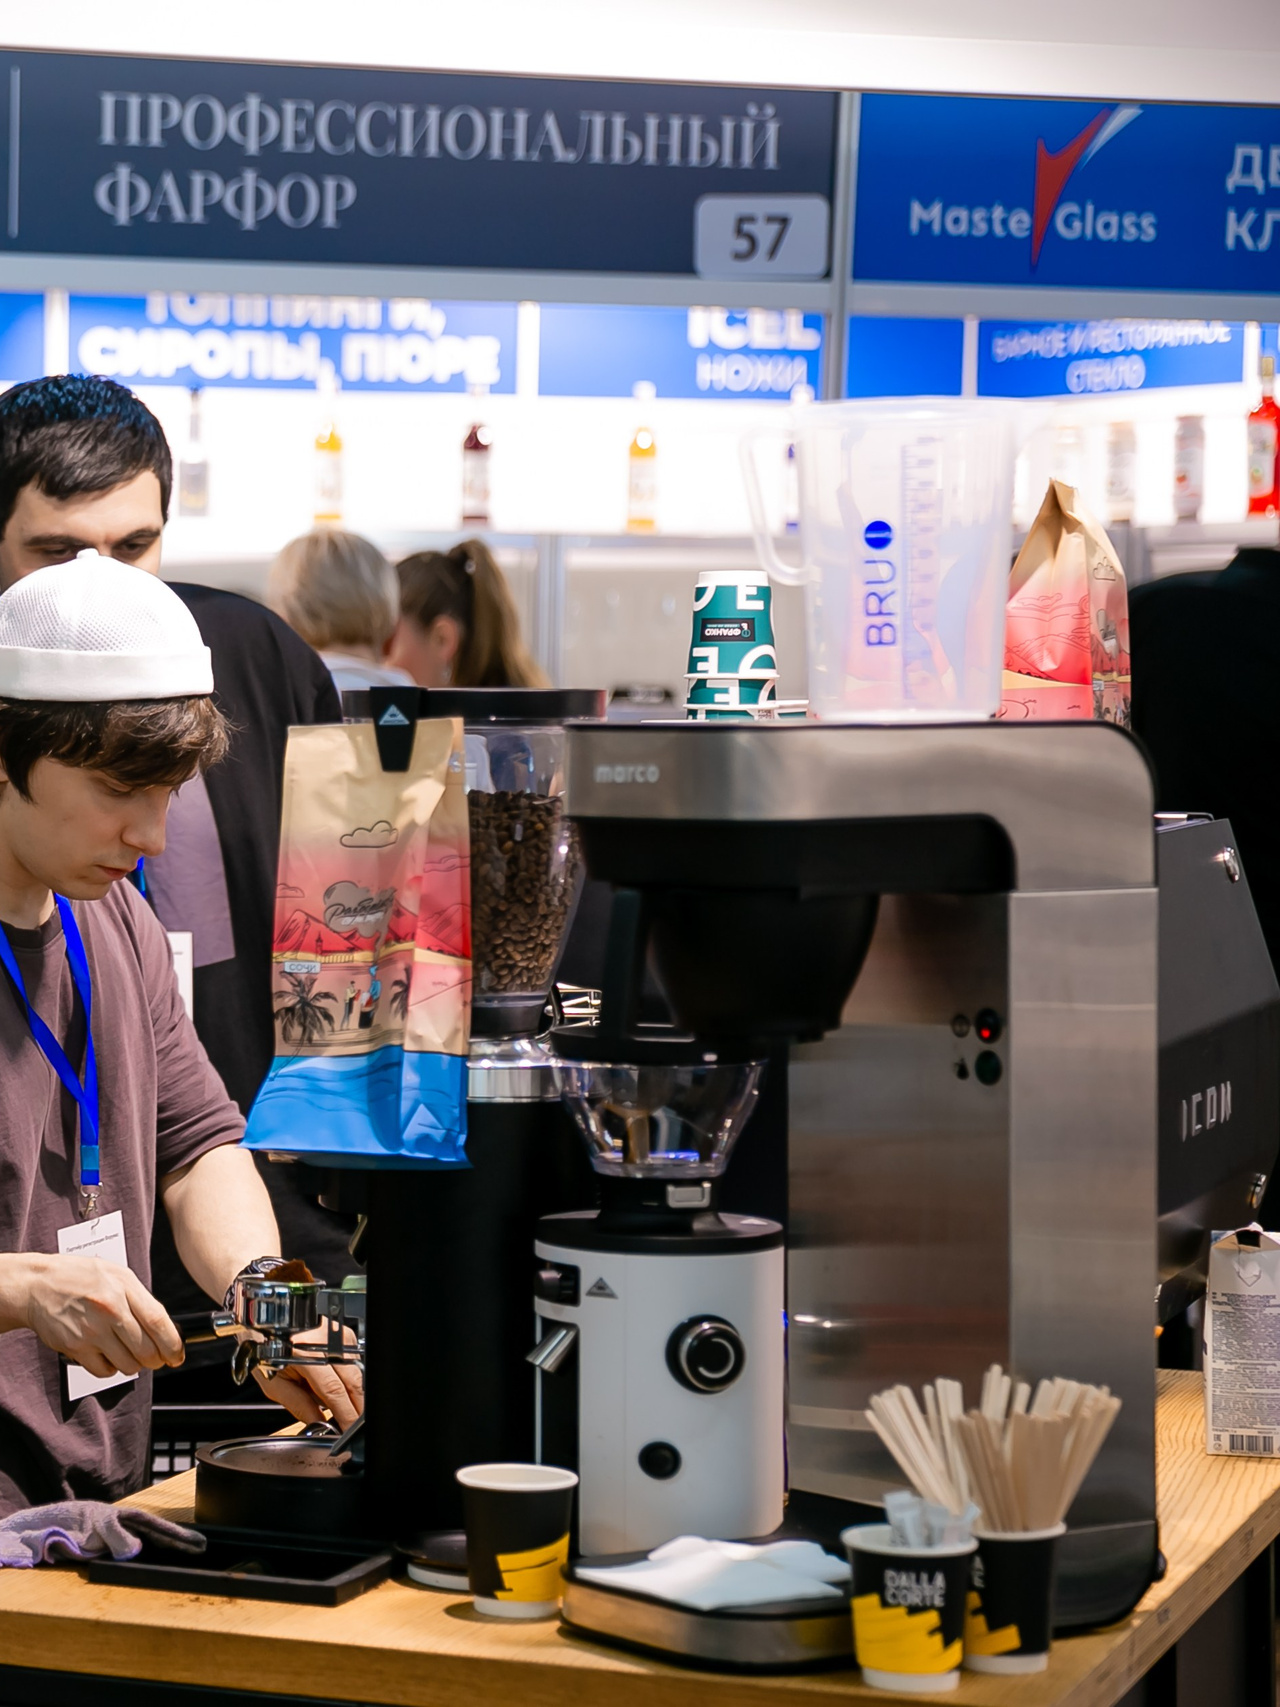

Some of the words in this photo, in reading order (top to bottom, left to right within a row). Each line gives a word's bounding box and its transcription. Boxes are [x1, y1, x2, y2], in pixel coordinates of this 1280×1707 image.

[97, 90, 783, 170] ПРОФЕССИОНАЛЬНЫЙ
[93, 162, 358, 231] ФАРФОР
[730, 213, 793, 263] 57
[687, 305, 821, 350] ICEL
[341, 331, 501, 385] ПЮРЕ
[594, 764, 660, 784] marco
[288, 962, 317, 973] СОЧИ
[1182, 1080, 1232, 1143] ICON
